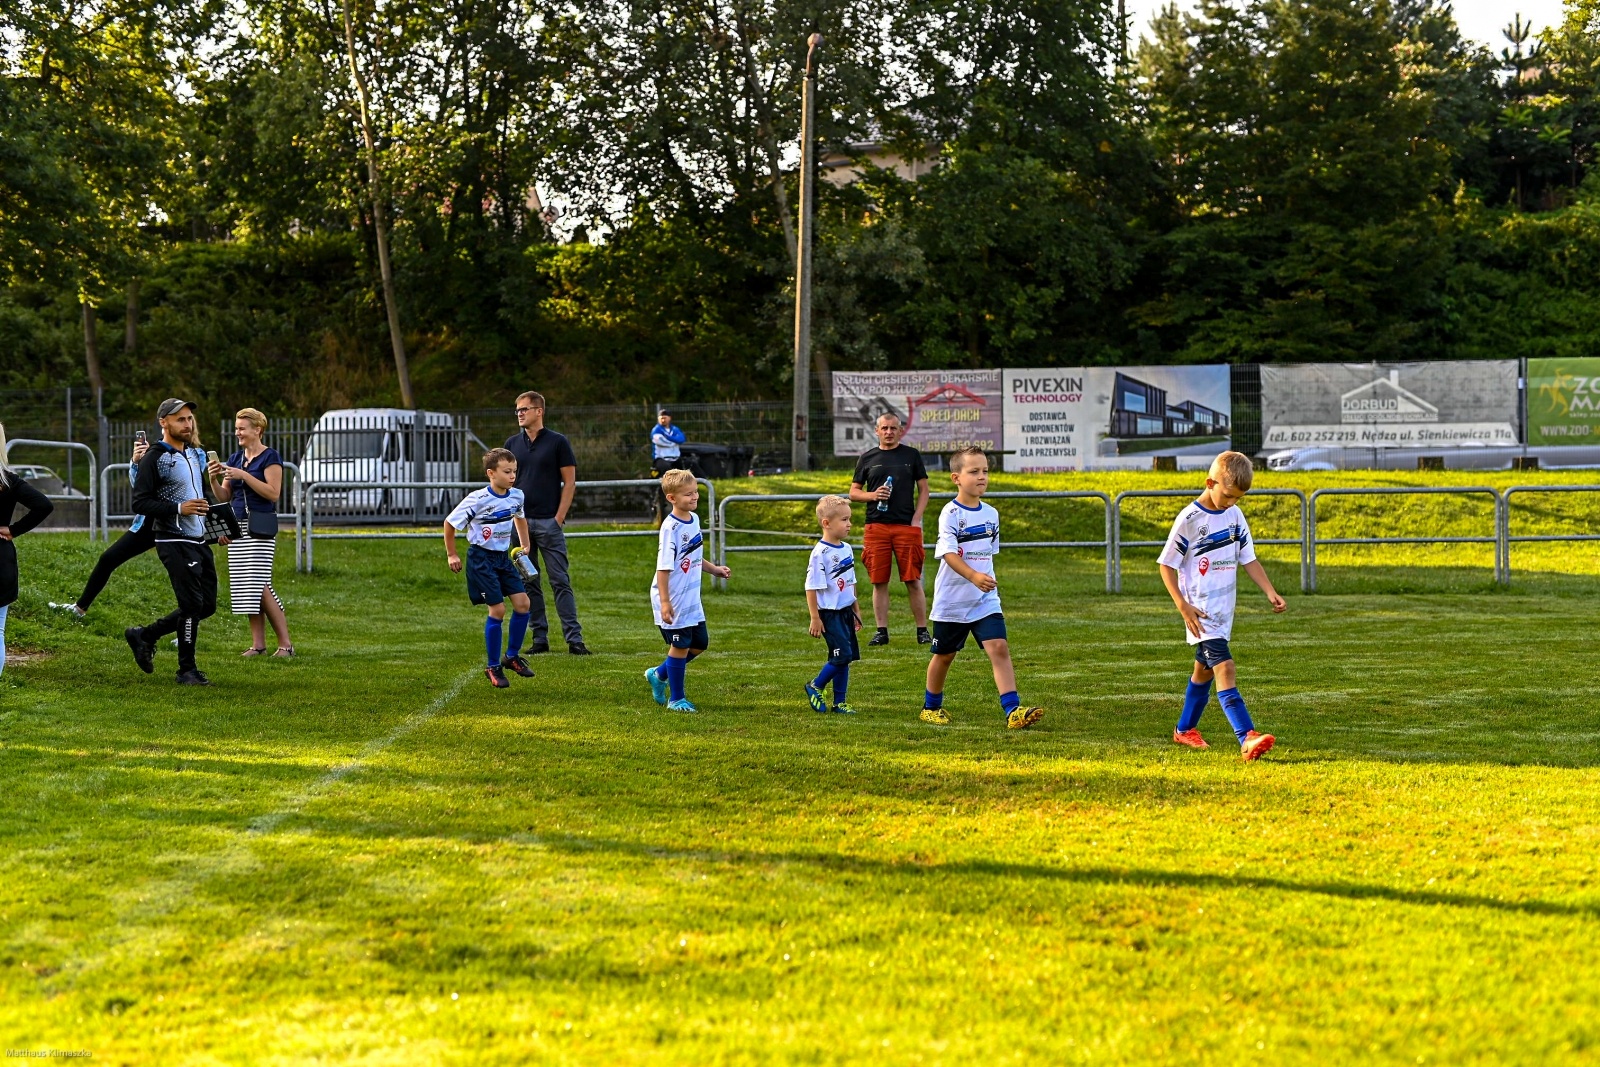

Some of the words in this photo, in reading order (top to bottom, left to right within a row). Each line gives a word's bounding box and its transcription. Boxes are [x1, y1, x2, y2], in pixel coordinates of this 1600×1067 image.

[836, 374, 872, 385] USŁUGI
[875, 373, 932, 385] CIESIELSKO
[941, 372, 999, 383] DEKARSKIE
[836, 385, 865, 395] DOMY
[869, 385, 890, 395] POD
[1012, 377, 1083, 393] PIVEXIN
[1013, 394, 1082, 403] TECHNOLOGY
[1342, 398, 1398, 410] DORBUD
[1029, 411, 1067, 421] DOSTAWCA
[1021, 423, 1075, 433] KOMPONENTÓW
[1030, 434, 1071, 446] ROZWIĄZAŃ
[1269, 431, 1288, 442] tel.
[1290, 431, 1312, 441] 602
[1314, 431, 1335, 441] 252
[1400, 430, 1414, 440] ul.
[1417, 428, 1491, 440] Sienkiewicza
[1495, 429, 1512, 439] 11a
[927, 440, 948, 451] 698
[1020, 448, 1034, 457] DLA
[1035, 447, 1077, 457] PRZEMYSŁU
